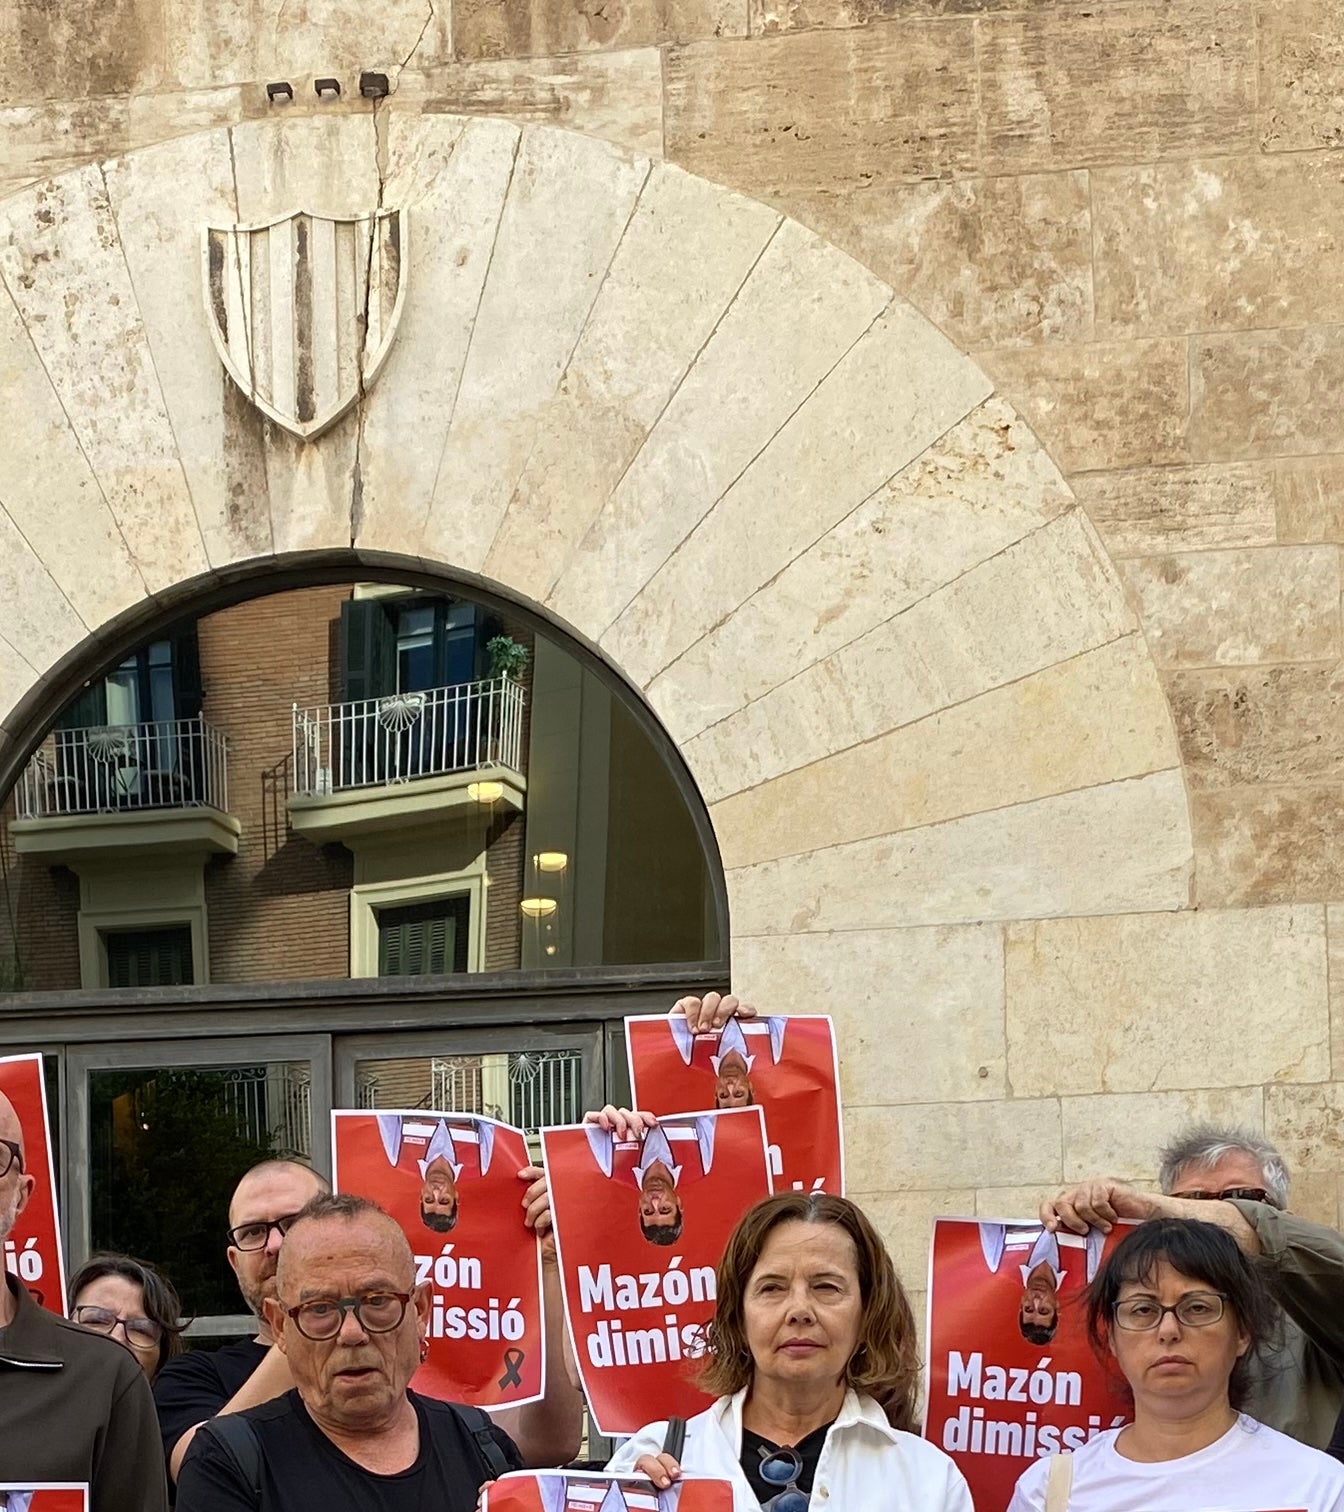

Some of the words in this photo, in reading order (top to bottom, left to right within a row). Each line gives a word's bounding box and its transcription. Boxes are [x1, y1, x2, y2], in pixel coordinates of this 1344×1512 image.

[414, 1244, 481, 1288] zón
[578, 1256, 716, 1312] Mazón
[426, 1295, 524, 1341] issió
[948, 1351, 1081, 1405] Mazón
